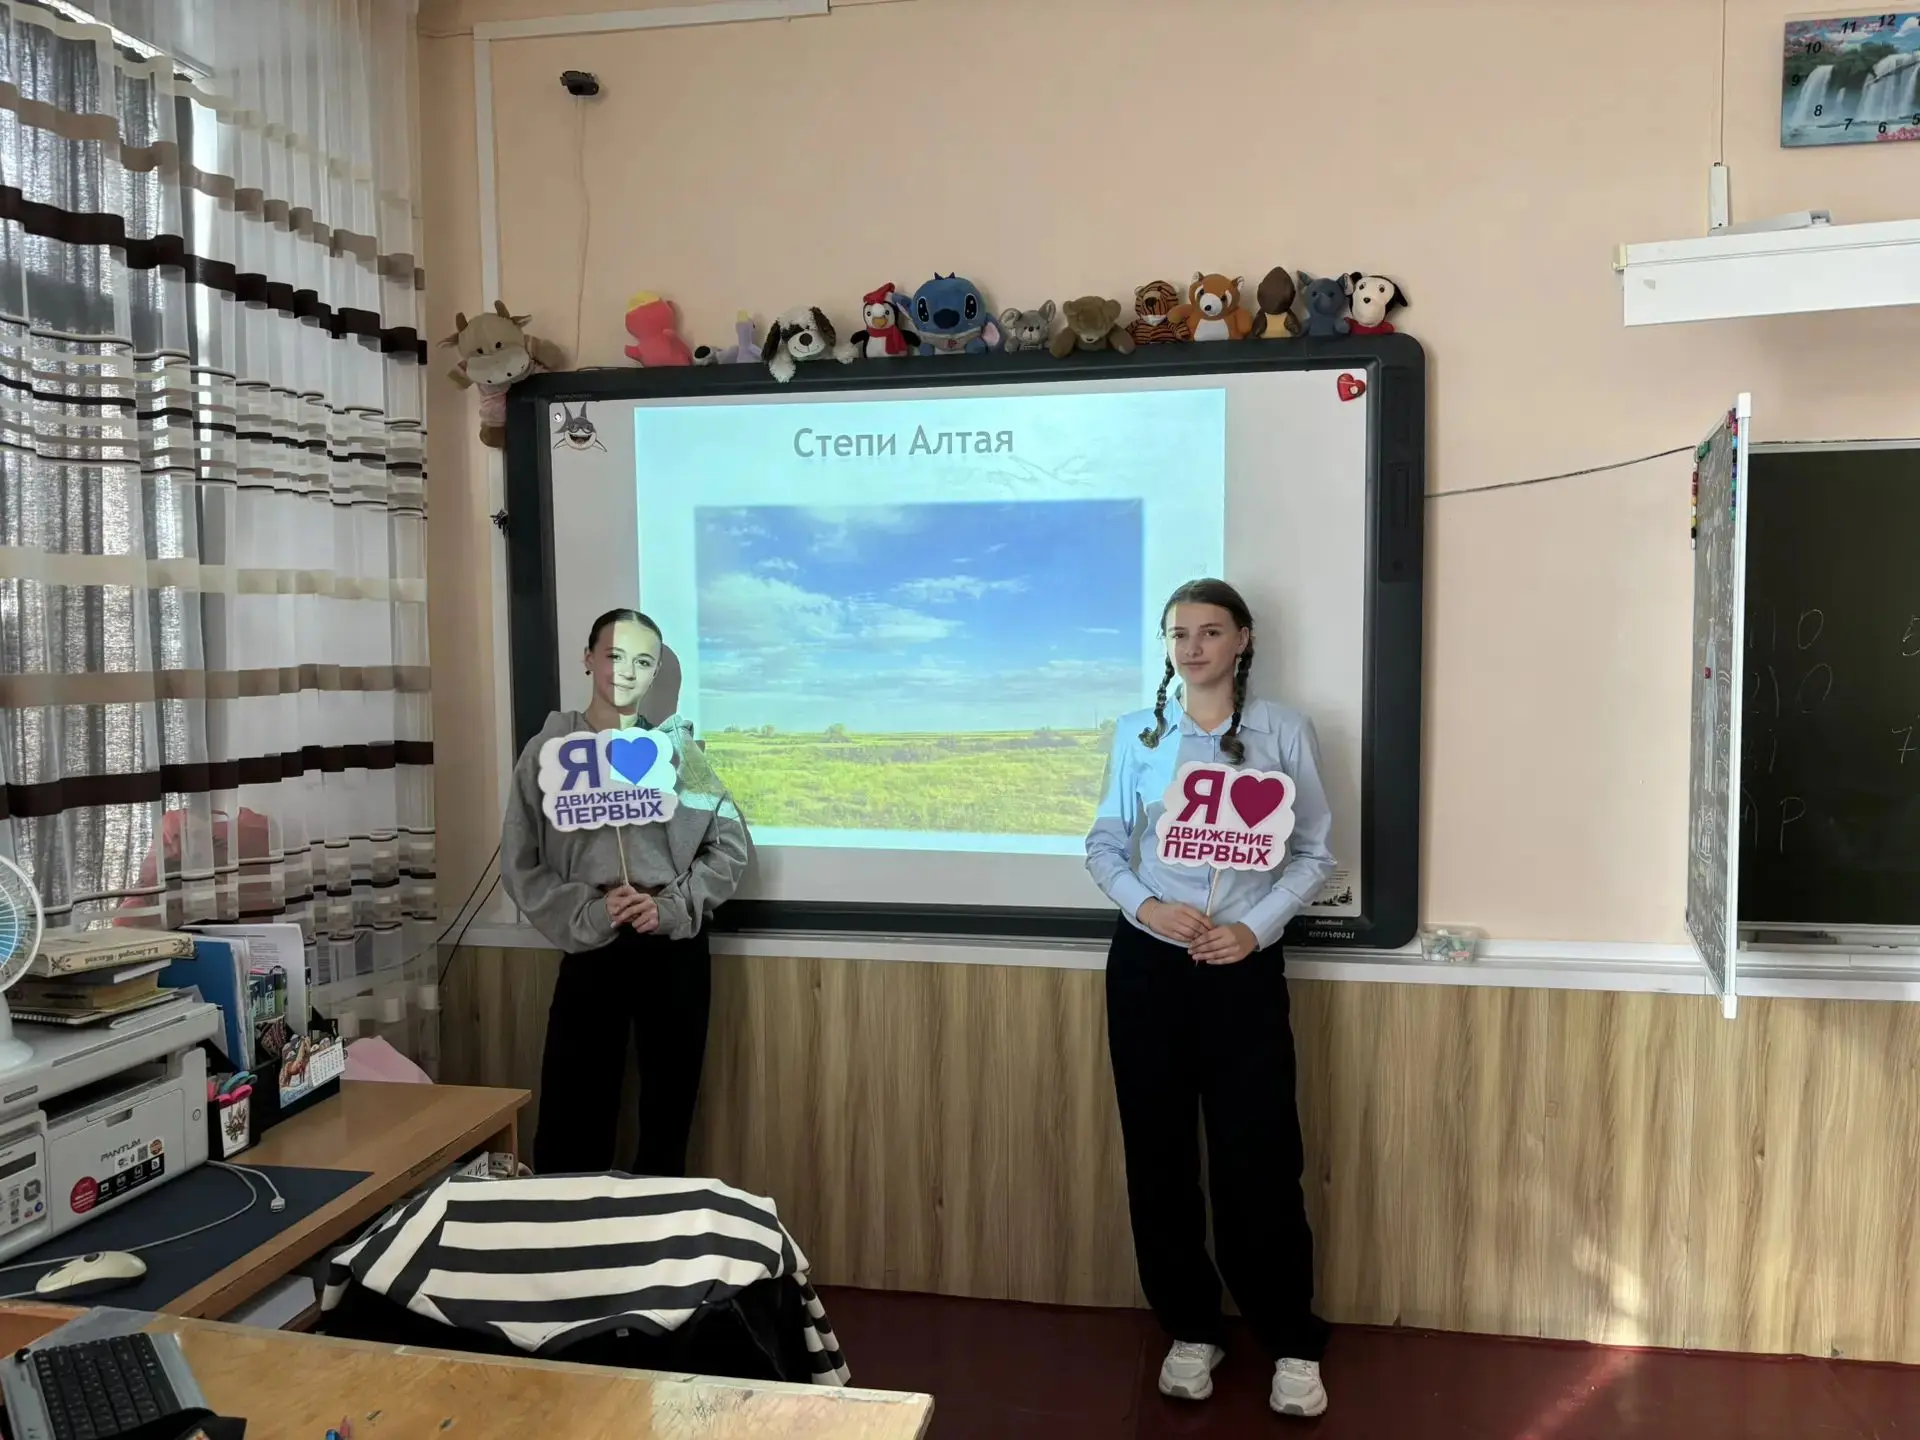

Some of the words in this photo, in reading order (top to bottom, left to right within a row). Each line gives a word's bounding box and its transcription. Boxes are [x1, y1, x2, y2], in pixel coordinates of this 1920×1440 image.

[1840, 21, 1857, 34] 11
[1879, 14, 1896, 27] 12
[1805, 41, 1822, 54] 10
[1791, 74, 1801, 87] 9
[1813, 104, 1823, 117] 8
[1911, 112, 1920, 126] 5
[1843, 118, 1854, 131] 7
[1878, 121, 1888, 134] 6
[793, 427, 897, 458] Степи
[908, 424, 1014, 456] Алтая
[558, 738, 602, 792] Я
[554, 787, 662, 810] ДВИЖЕНИЕ
[1176, 769, 1226, 825] Я
[555, 800, 664, 826] ПЕРВЫХ
[1165, 825, 1273, 848] ДВИЖЕНИЕ
[1163, 840, 1272, 866] ПЕРВЫХ
[100, 1138, 141, 1162] PANTUM
